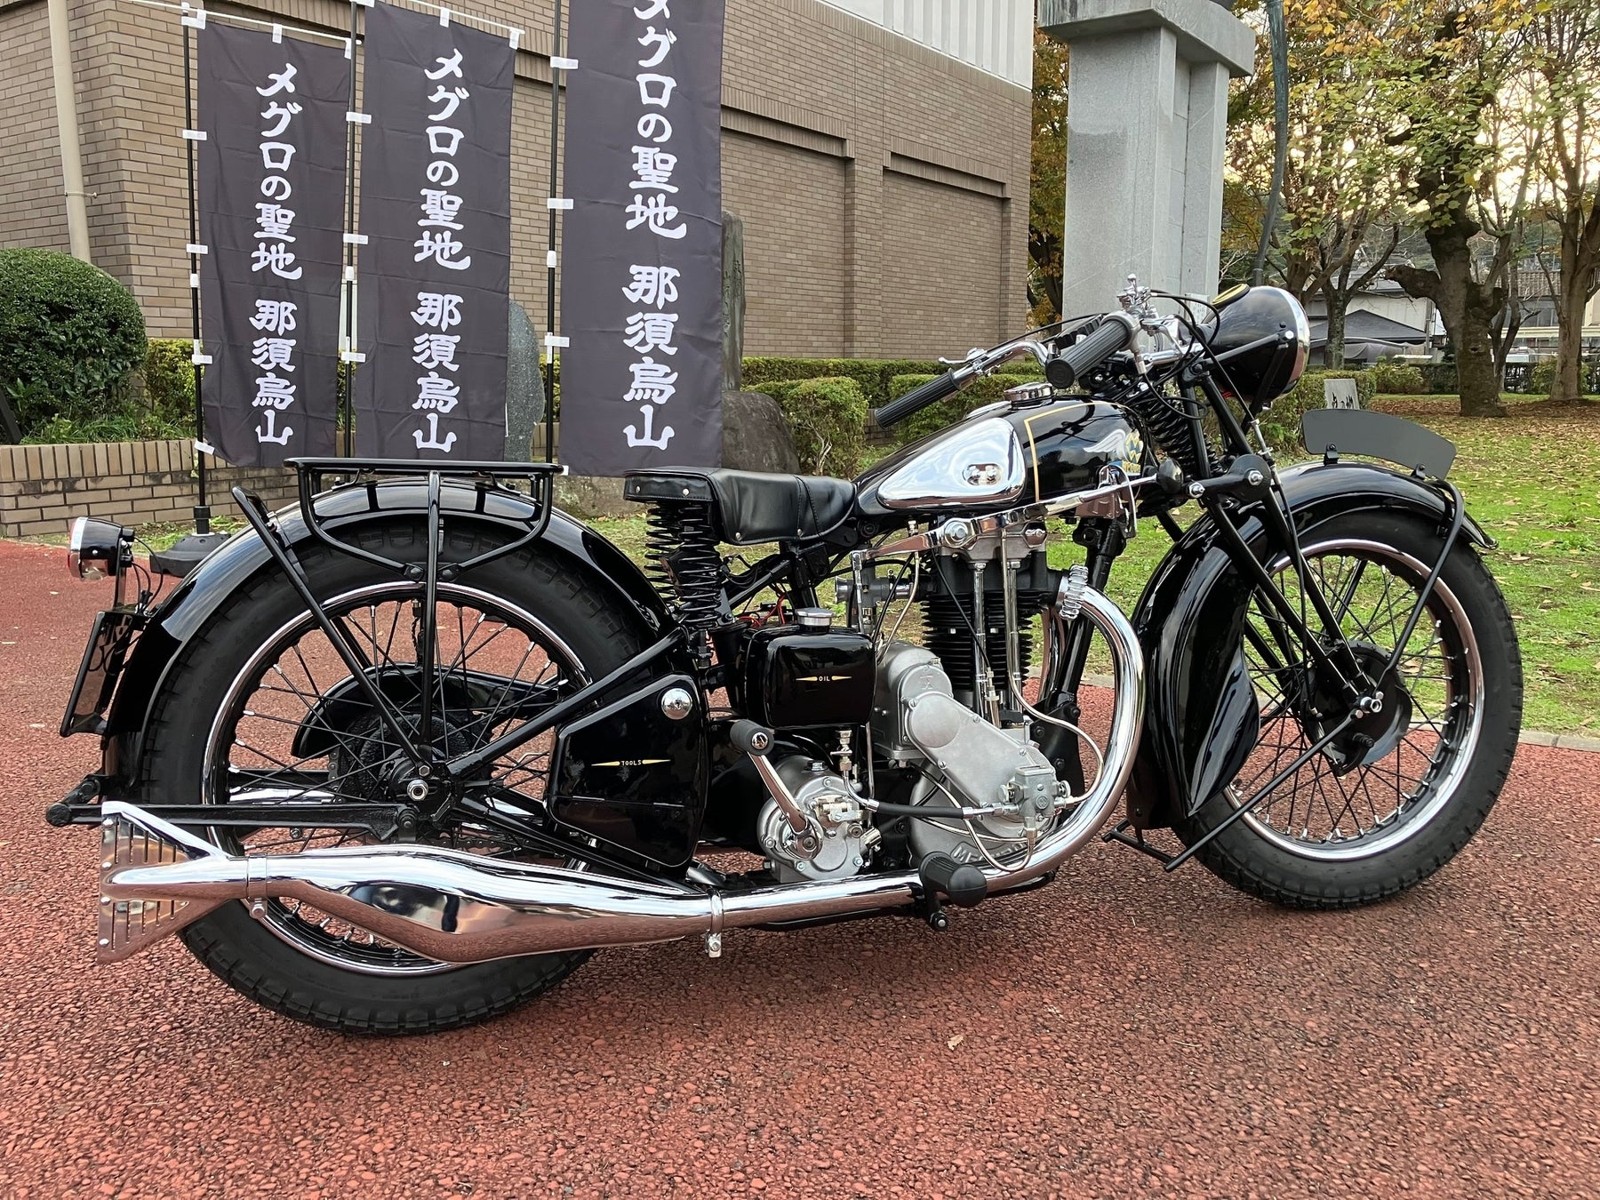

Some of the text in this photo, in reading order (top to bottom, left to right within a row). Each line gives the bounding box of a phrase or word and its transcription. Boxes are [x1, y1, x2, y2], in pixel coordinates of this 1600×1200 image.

[248, 62, 303, 446] メグロの聖地 那須烏山
[410, 48, 471, 453] メグロの聖地 那須烏山
[621, 264, 681, 451] 那須烏山
[620, 759, 642, 767] TOOLS
